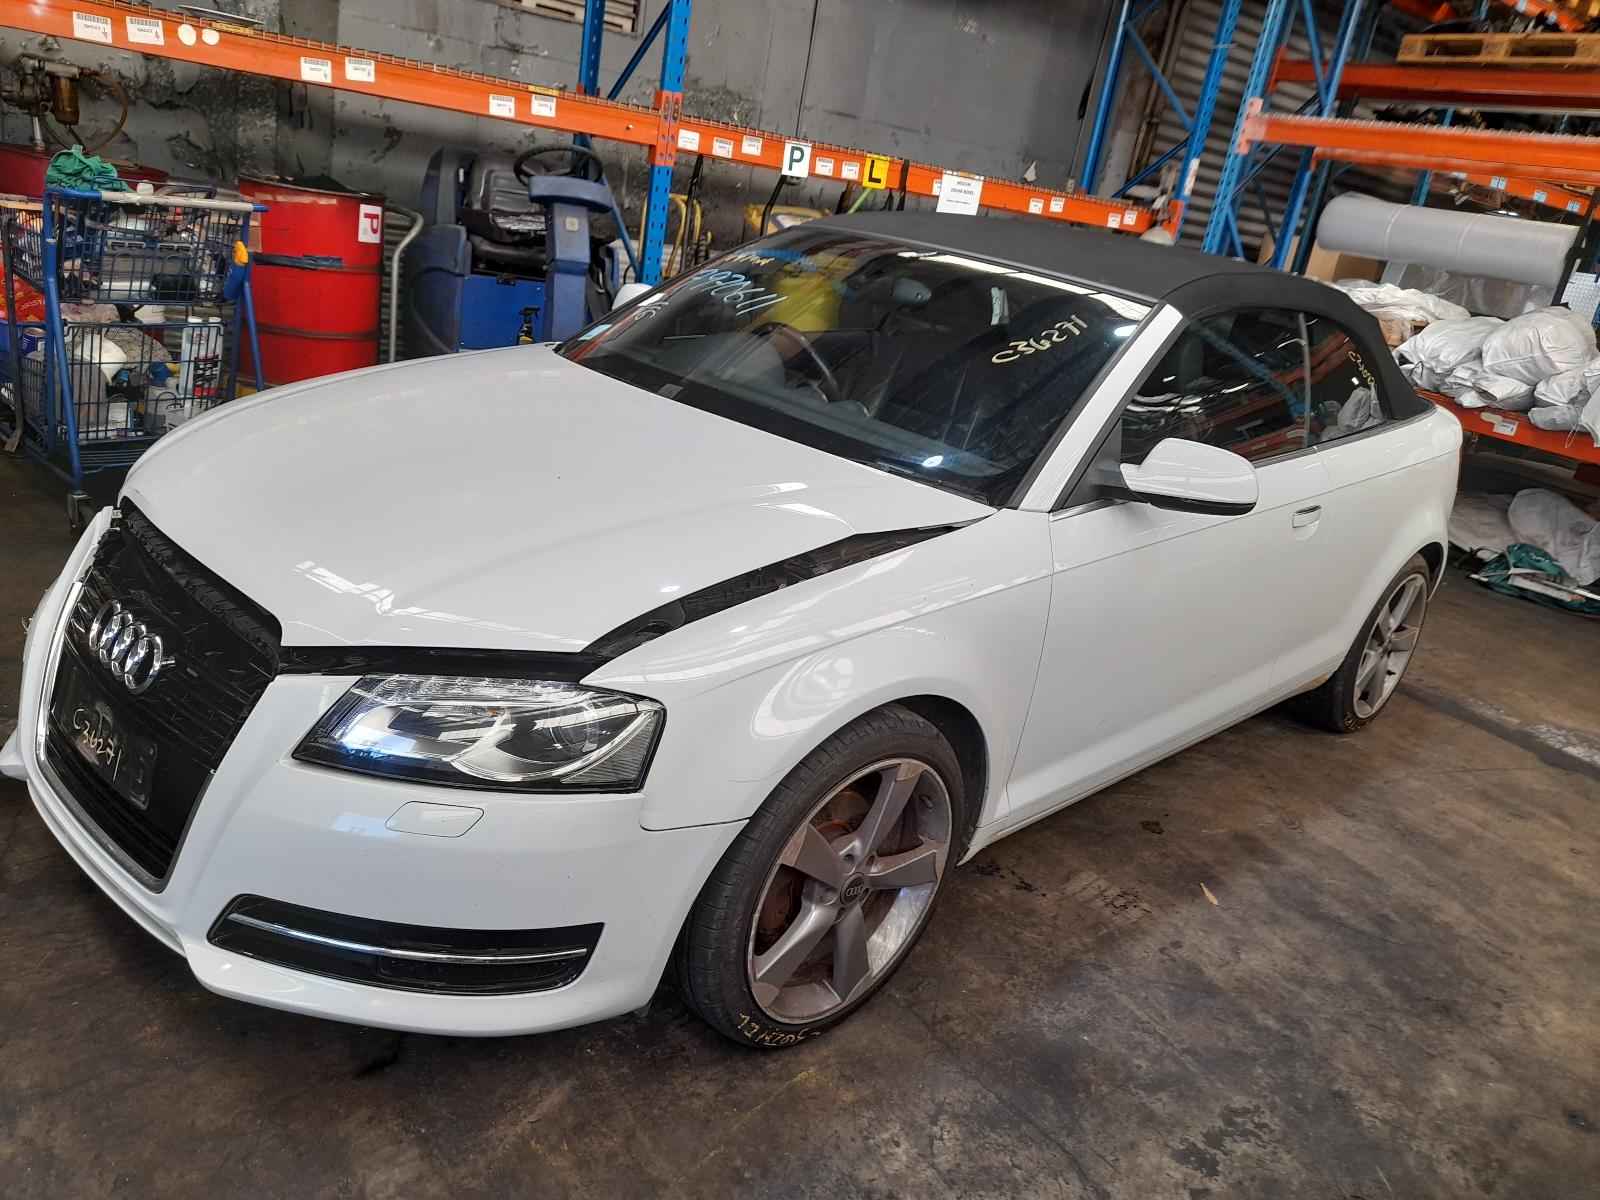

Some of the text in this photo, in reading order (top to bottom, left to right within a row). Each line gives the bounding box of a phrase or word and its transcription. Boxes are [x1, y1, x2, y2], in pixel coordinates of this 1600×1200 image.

[788, 145, 805, 171] P
[868, 159, 882, 184] L
[363, 212, 380, 235] P
[17, 297, 46, 316] CHRIST
[991, 314, 1088, 364] C36271
[73, 708, 122, 782] C36271
